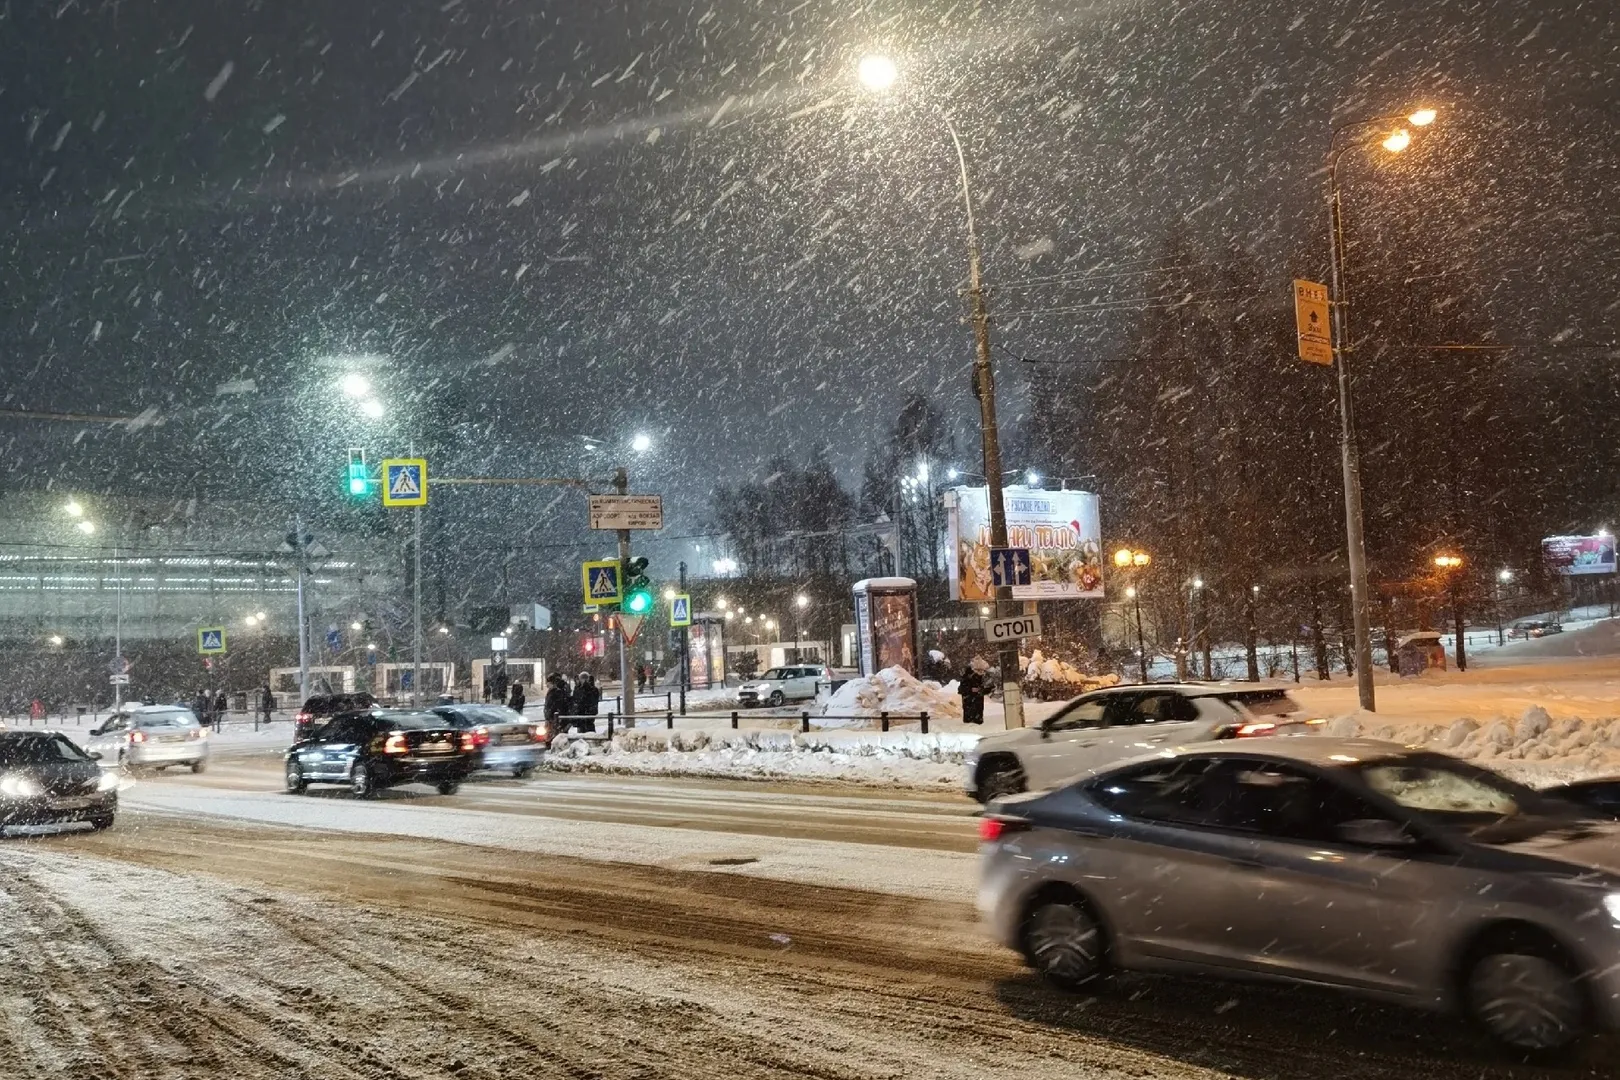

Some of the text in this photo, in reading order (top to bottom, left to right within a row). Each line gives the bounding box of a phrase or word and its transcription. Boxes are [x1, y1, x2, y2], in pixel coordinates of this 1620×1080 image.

[1011, 499, 1033, 512] РУССКОЕ
[1034, 500, 1051, 512] РАДИО
[979, 524, 1077, 549] ПОАРИ ТЕПЛО
[993, 619, 1035, 638] СТОП
